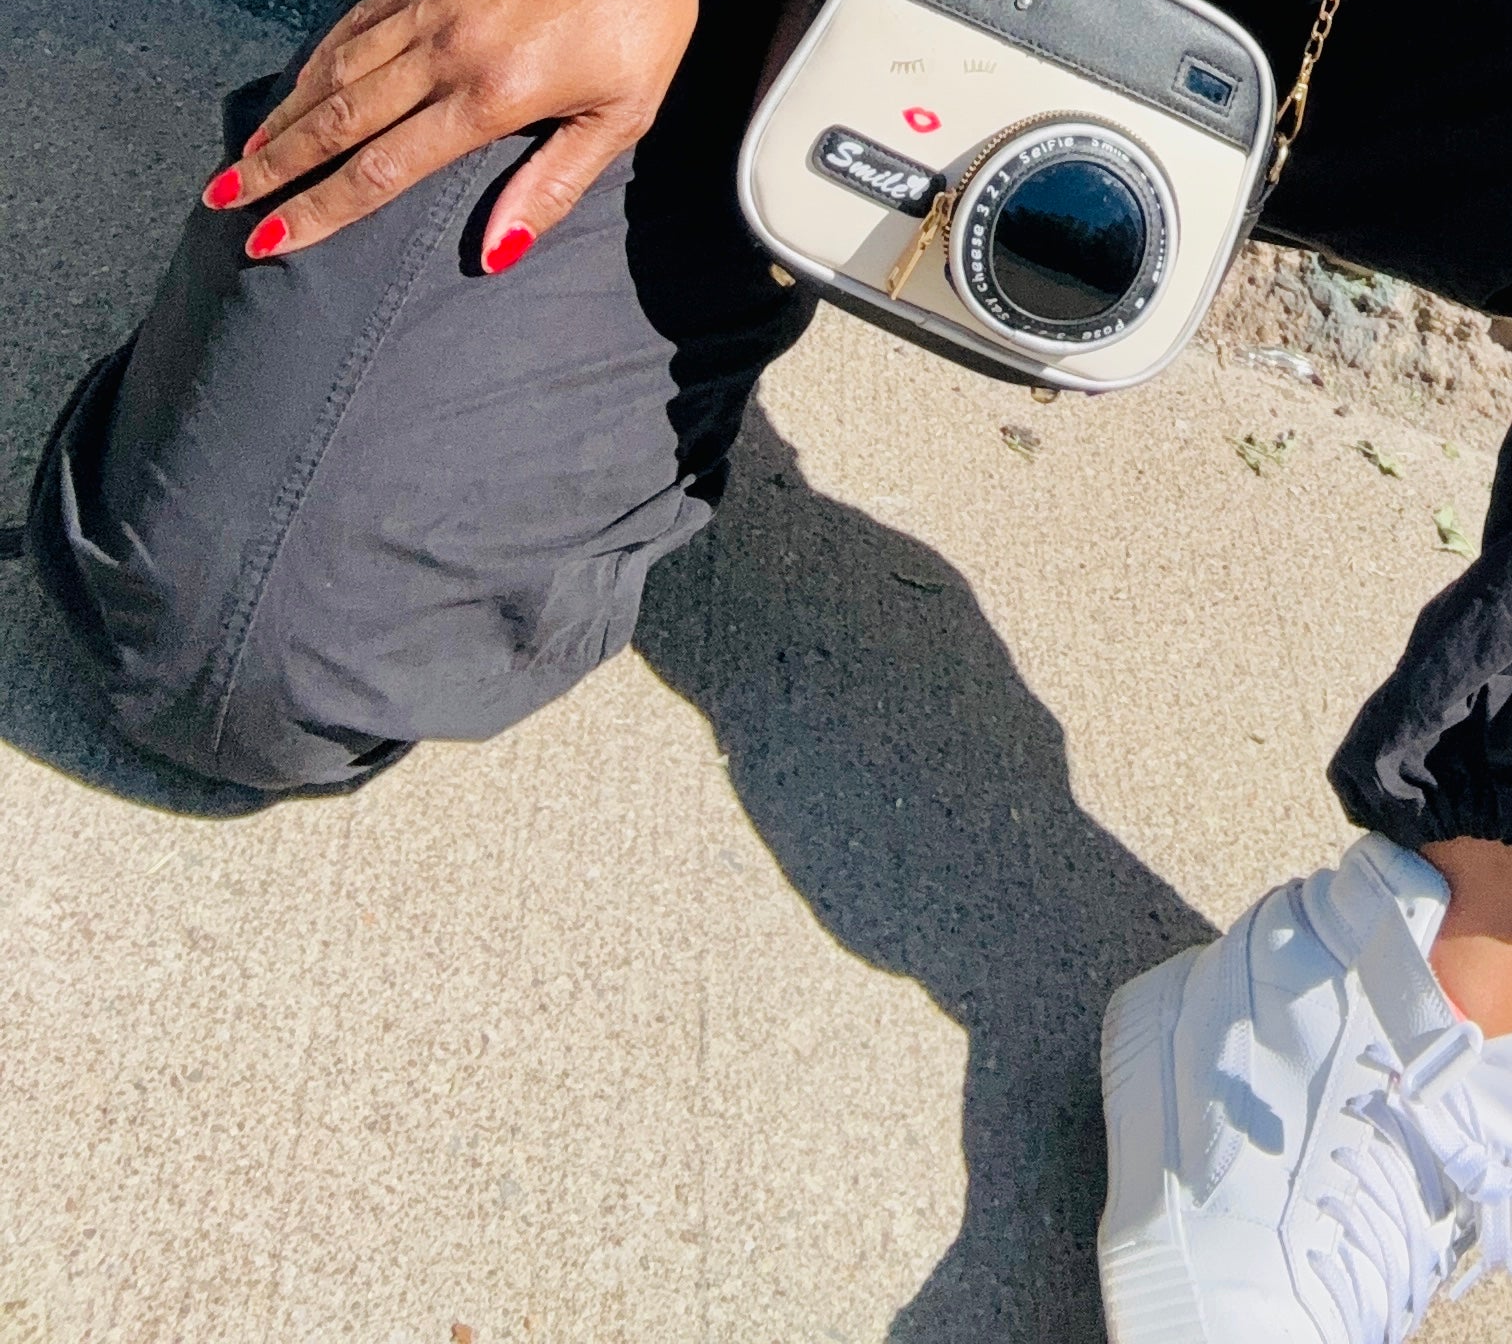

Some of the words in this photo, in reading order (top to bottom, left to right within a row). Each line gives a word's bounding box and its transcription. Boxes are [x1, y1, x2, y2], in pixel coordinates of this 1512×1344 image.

[826, 141, 906, 200] Smile
[976, 205, 990, 218] 3
[986, 184, 1000, 199] 2
